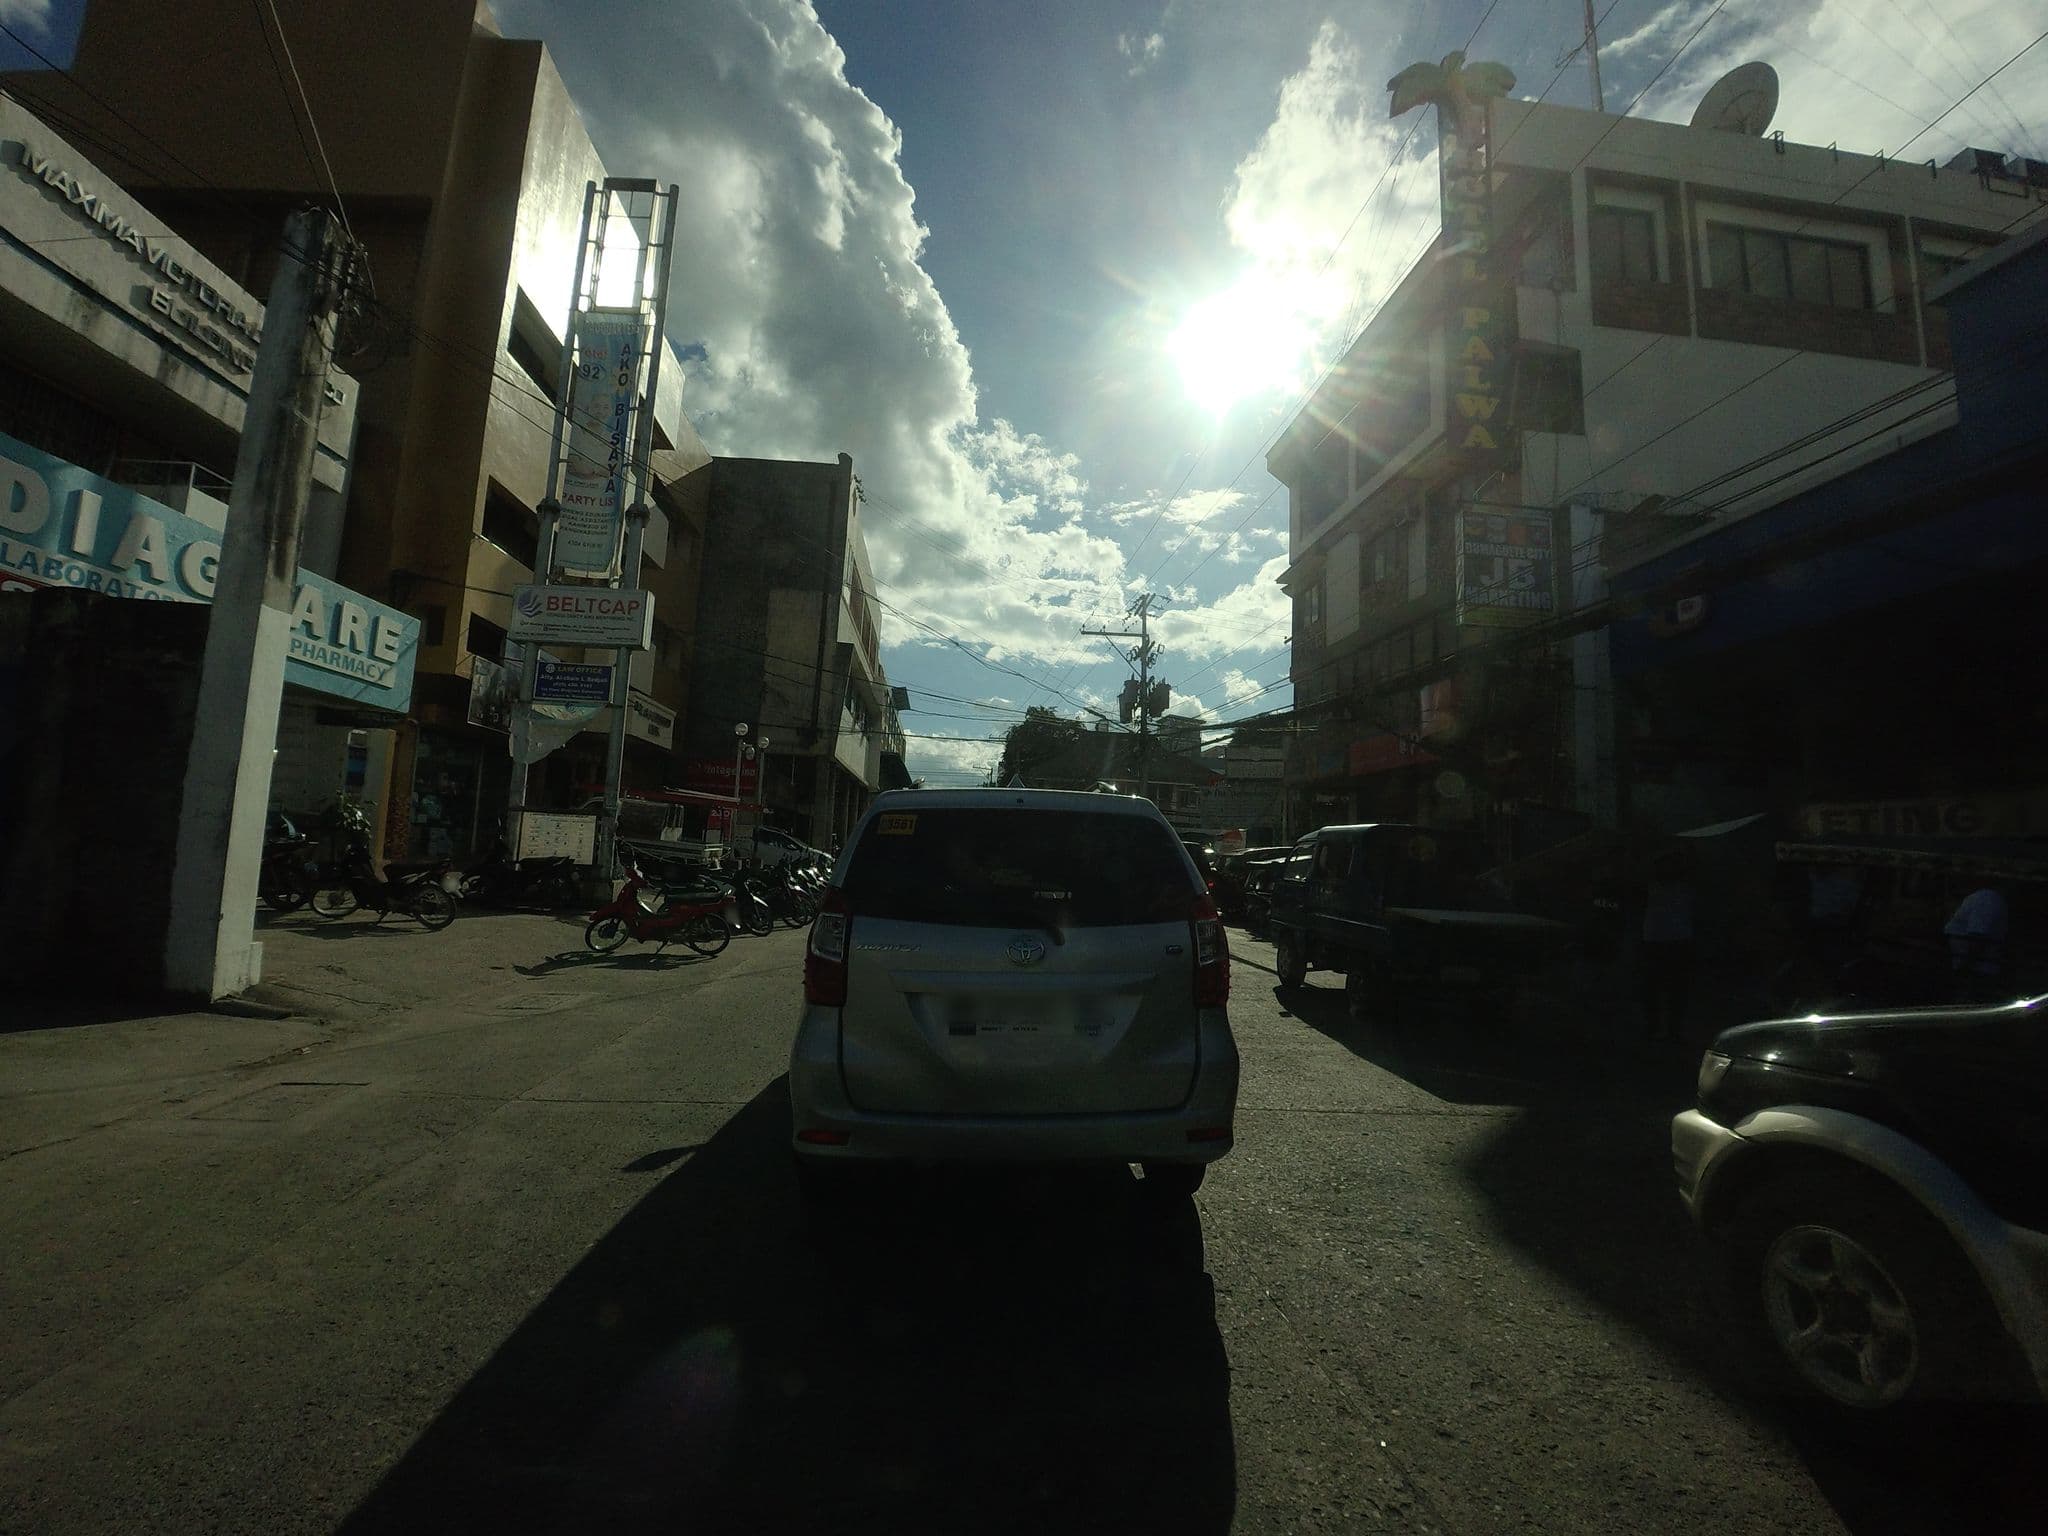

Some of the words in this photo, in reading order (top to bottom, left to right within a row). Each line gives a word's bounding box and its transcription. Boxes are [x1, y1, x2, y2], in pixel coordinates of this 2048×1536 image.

[21, 150, 145, 255] MAXIMA
[1455, 305, 1499, 449] PALWA
[546, 596, 640, 615] BELTCAP
[290, 638, 387, 682] PHARMACY
